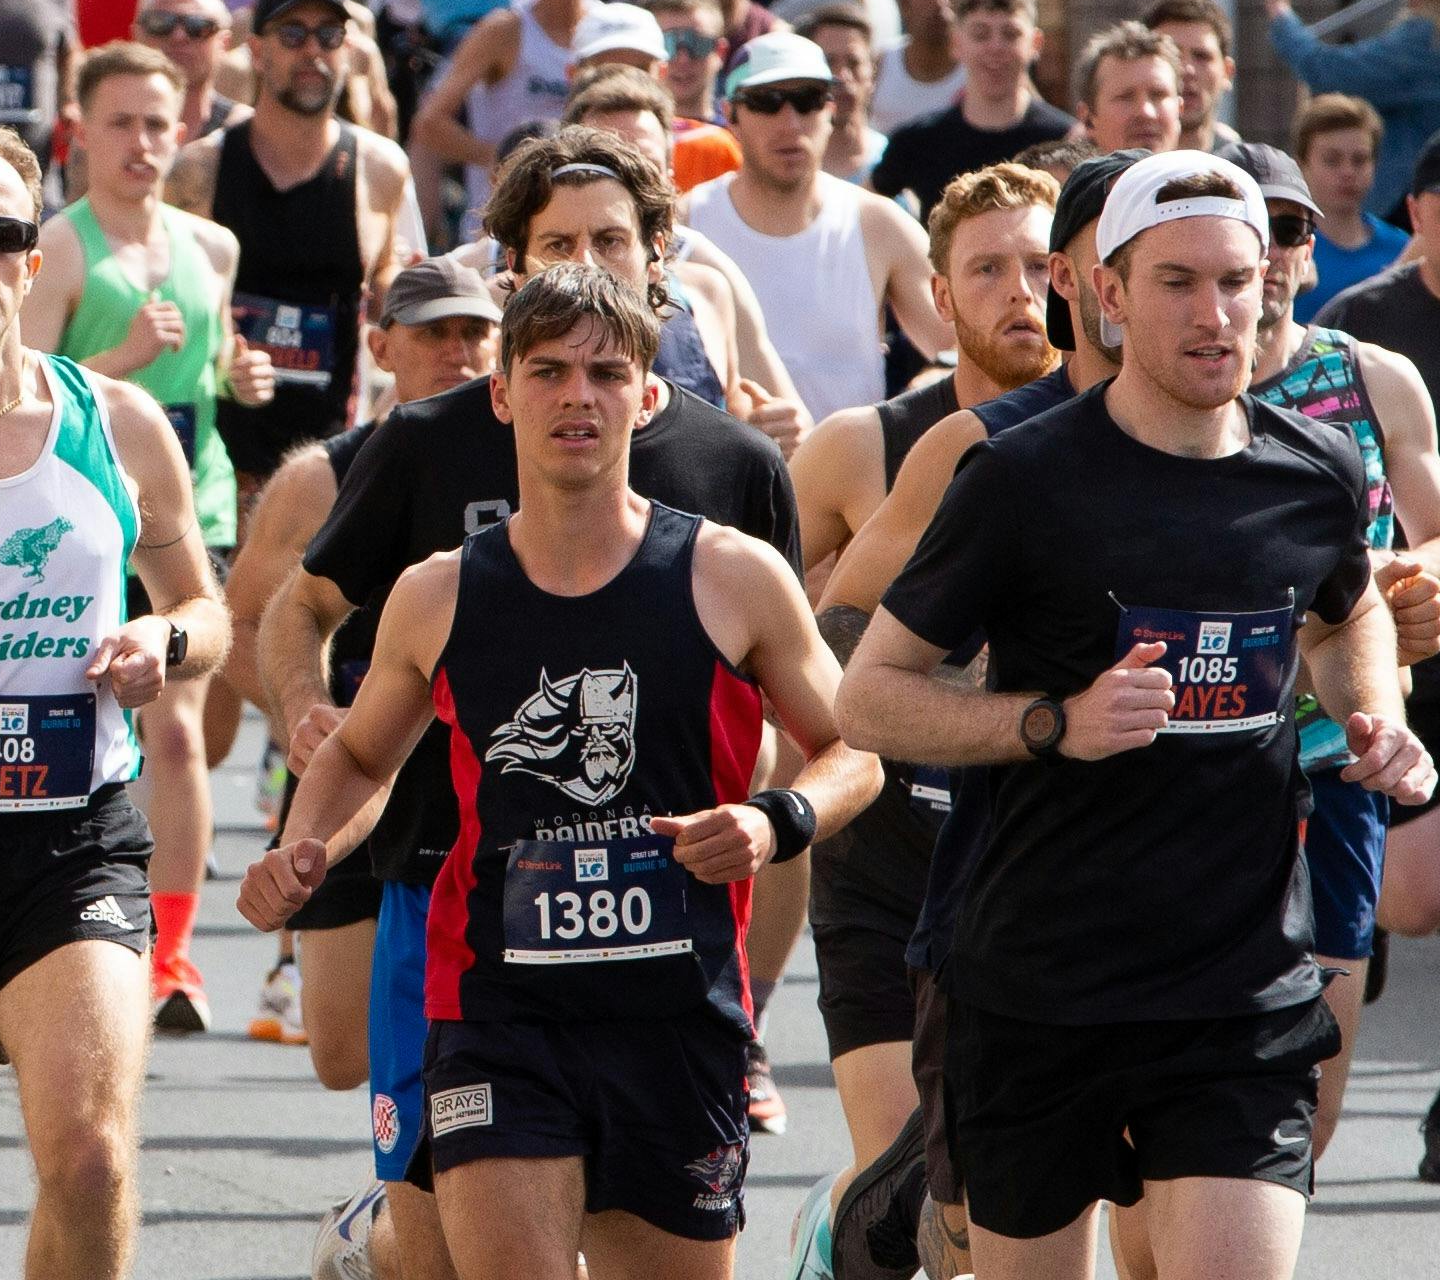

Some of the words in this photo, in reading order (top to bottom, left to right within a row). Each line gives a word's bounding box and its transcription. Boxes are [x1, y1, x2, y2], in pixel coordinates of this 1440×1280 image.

[1178, 656, 1239, 684] 1085
[533, 804, 653, 829] WODONGA
[579, 862, 605, 878] 10
[534, 886, 652, 940] 1380
[436, 1092, 485, 1115] GRAYS
